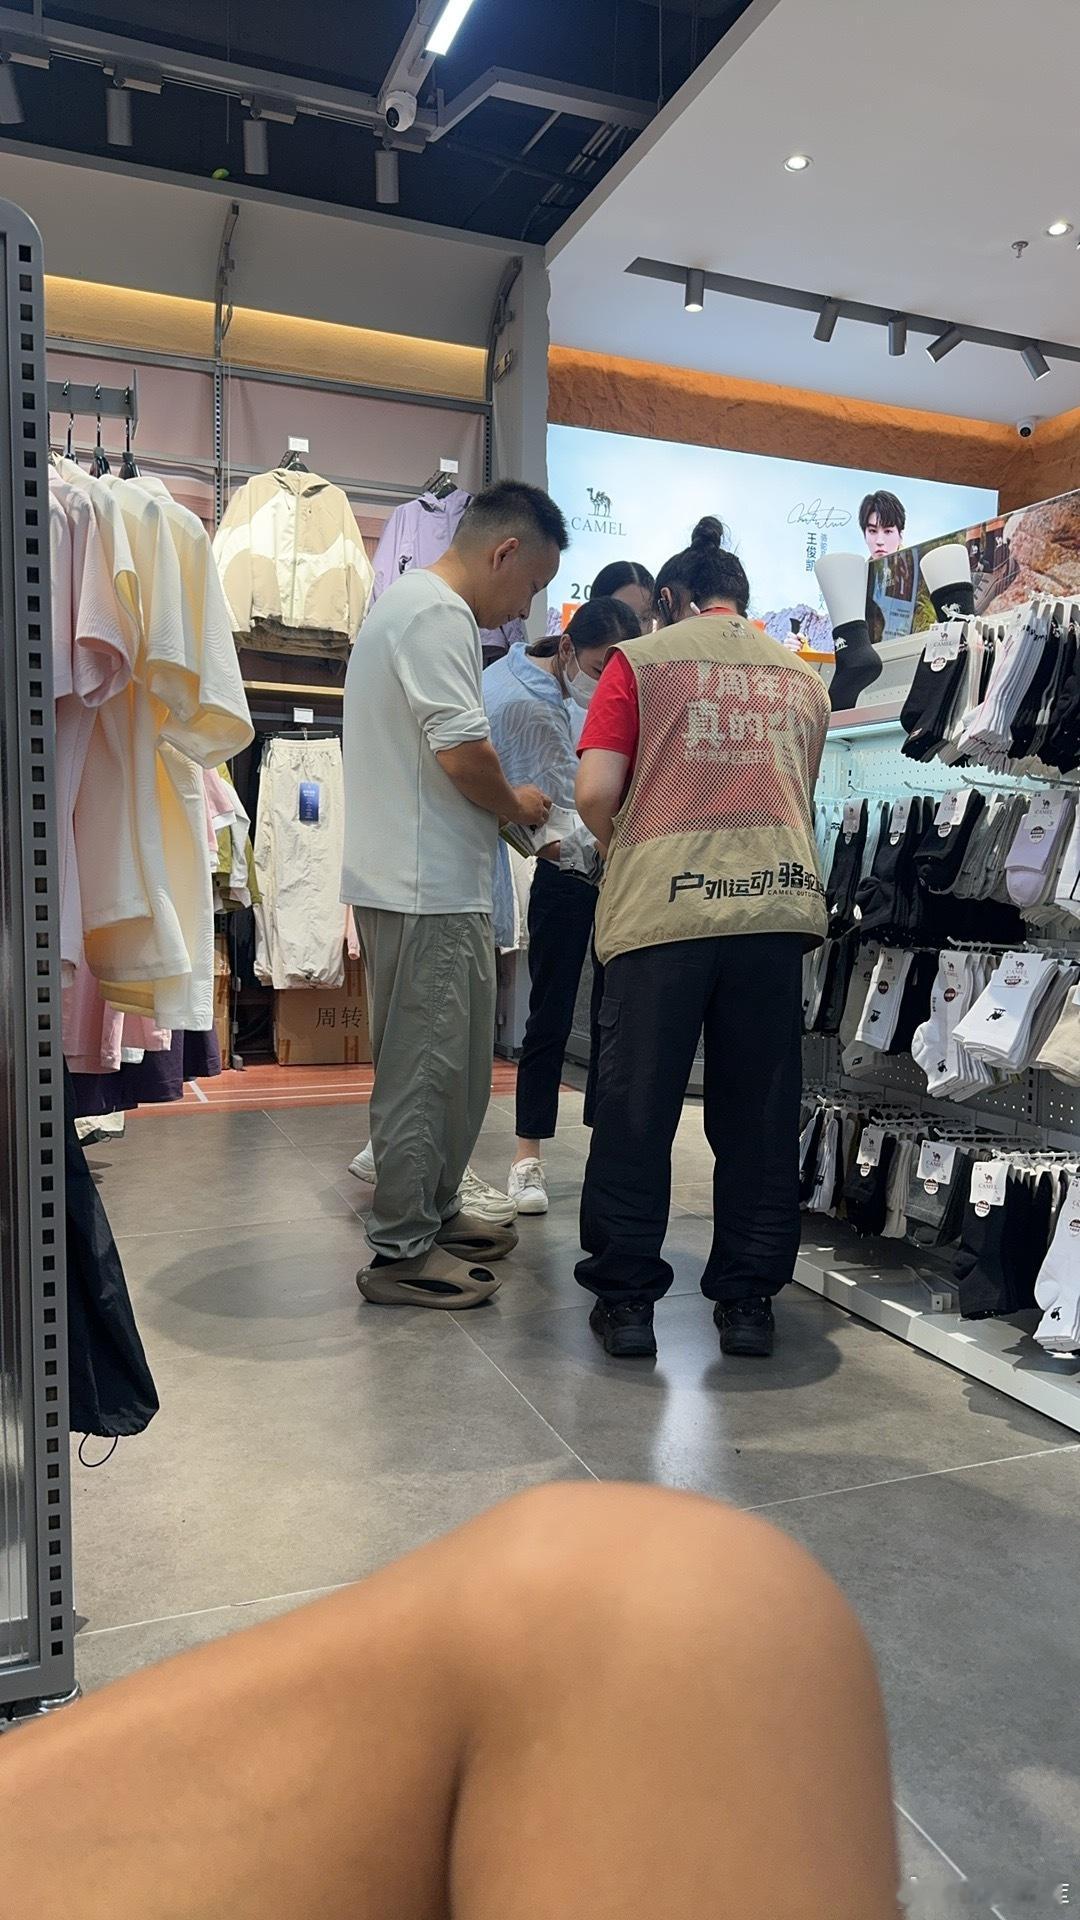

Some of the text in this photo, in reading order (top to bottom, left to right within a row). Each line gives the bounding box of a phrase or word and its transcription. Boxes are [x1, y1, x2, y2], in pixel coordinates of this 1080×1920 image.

[571, 516, 627, 536] CAMEL
[669, 870, 773, 902] 户外运动
[315, 1006, 368, 1030] 周转
